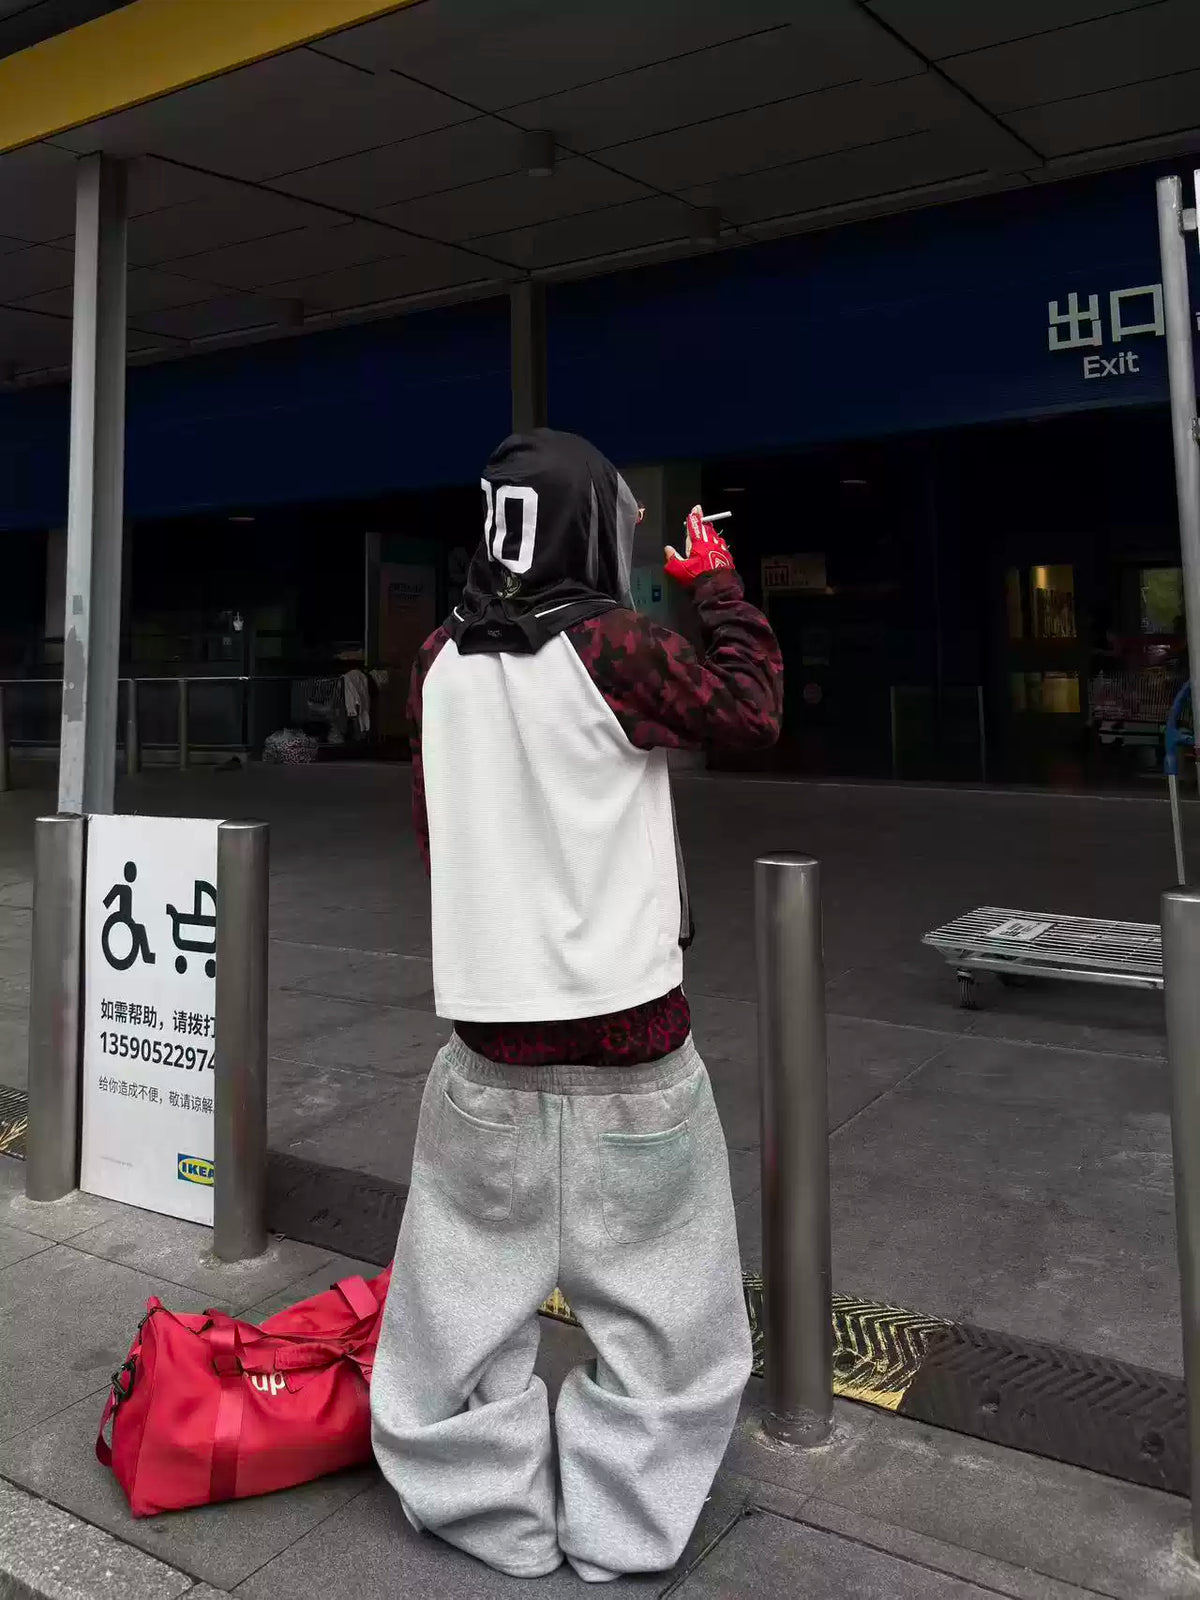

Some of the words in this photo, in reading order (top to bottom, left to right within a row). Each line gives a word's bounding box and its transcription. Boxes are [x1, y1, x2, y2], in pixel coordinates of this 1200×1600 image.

[1048, 283, 1165, 351] 出口
[1083, 351, 1140, 379] Exit
[244, 1371, 287, 1396] up
